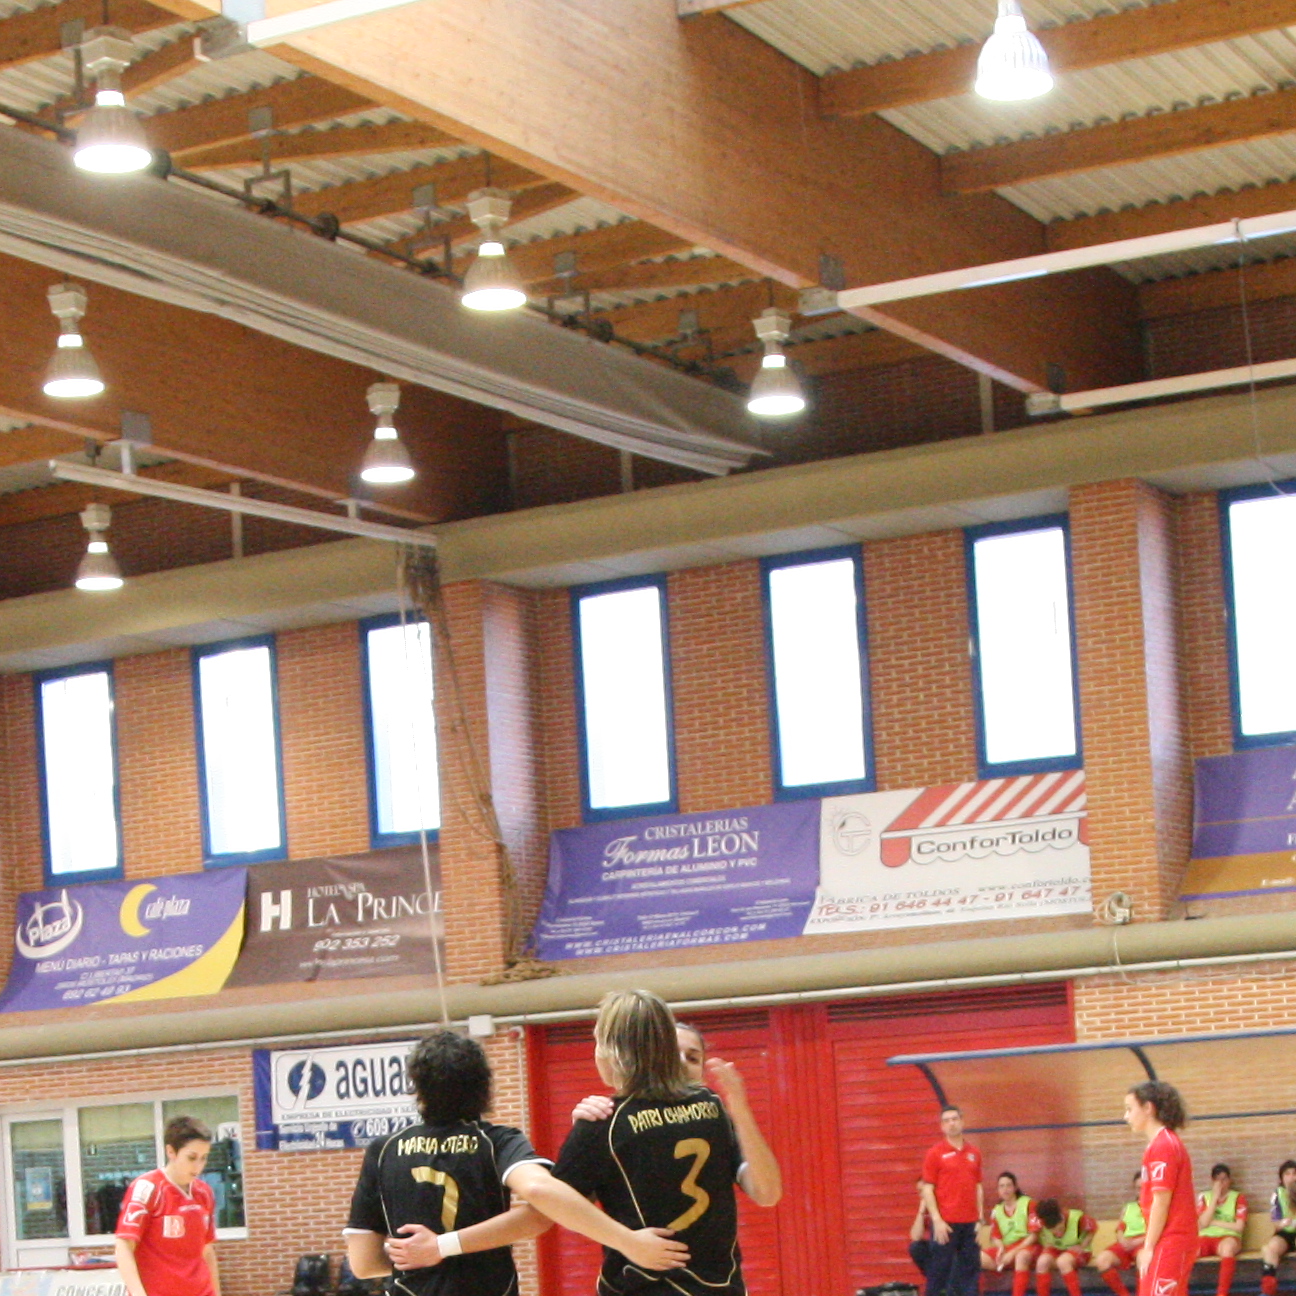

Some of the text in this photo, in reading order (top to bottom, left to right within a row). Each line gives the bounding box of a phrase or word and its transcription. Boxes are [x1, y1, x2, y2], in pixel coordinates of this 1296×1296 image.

[644, 816, 749, 842] CRISTALERIAS
[917, 827, 1073, 855] ConforToldo
[602, 831, 760, 868] Formas LEON
[665, 863, 679, 876] DE
[907, 888, 960, 899] TOLDOS
[260, 889, 292, 933] H
[65, 955, 101, 970] DIARIO
[108, 952, 141, 966] TAPAS
[141, 950, 149, 962] Y
[149, 944, 204, 960] RACIONES
[342, 937, 370, 951] 353
[322, 1111, 333, 1119] DE
[365, 1117, 390, 1137] 609
[627, 1101, 720, 1134] PATRI CHAMORRO
[397, 1136, 439, 1156] MARIA
[440, 1133, 479, 1155] OTERO
[665, 1137, 711, 1232] 3
[410, 1165, 459, 1232] 7
